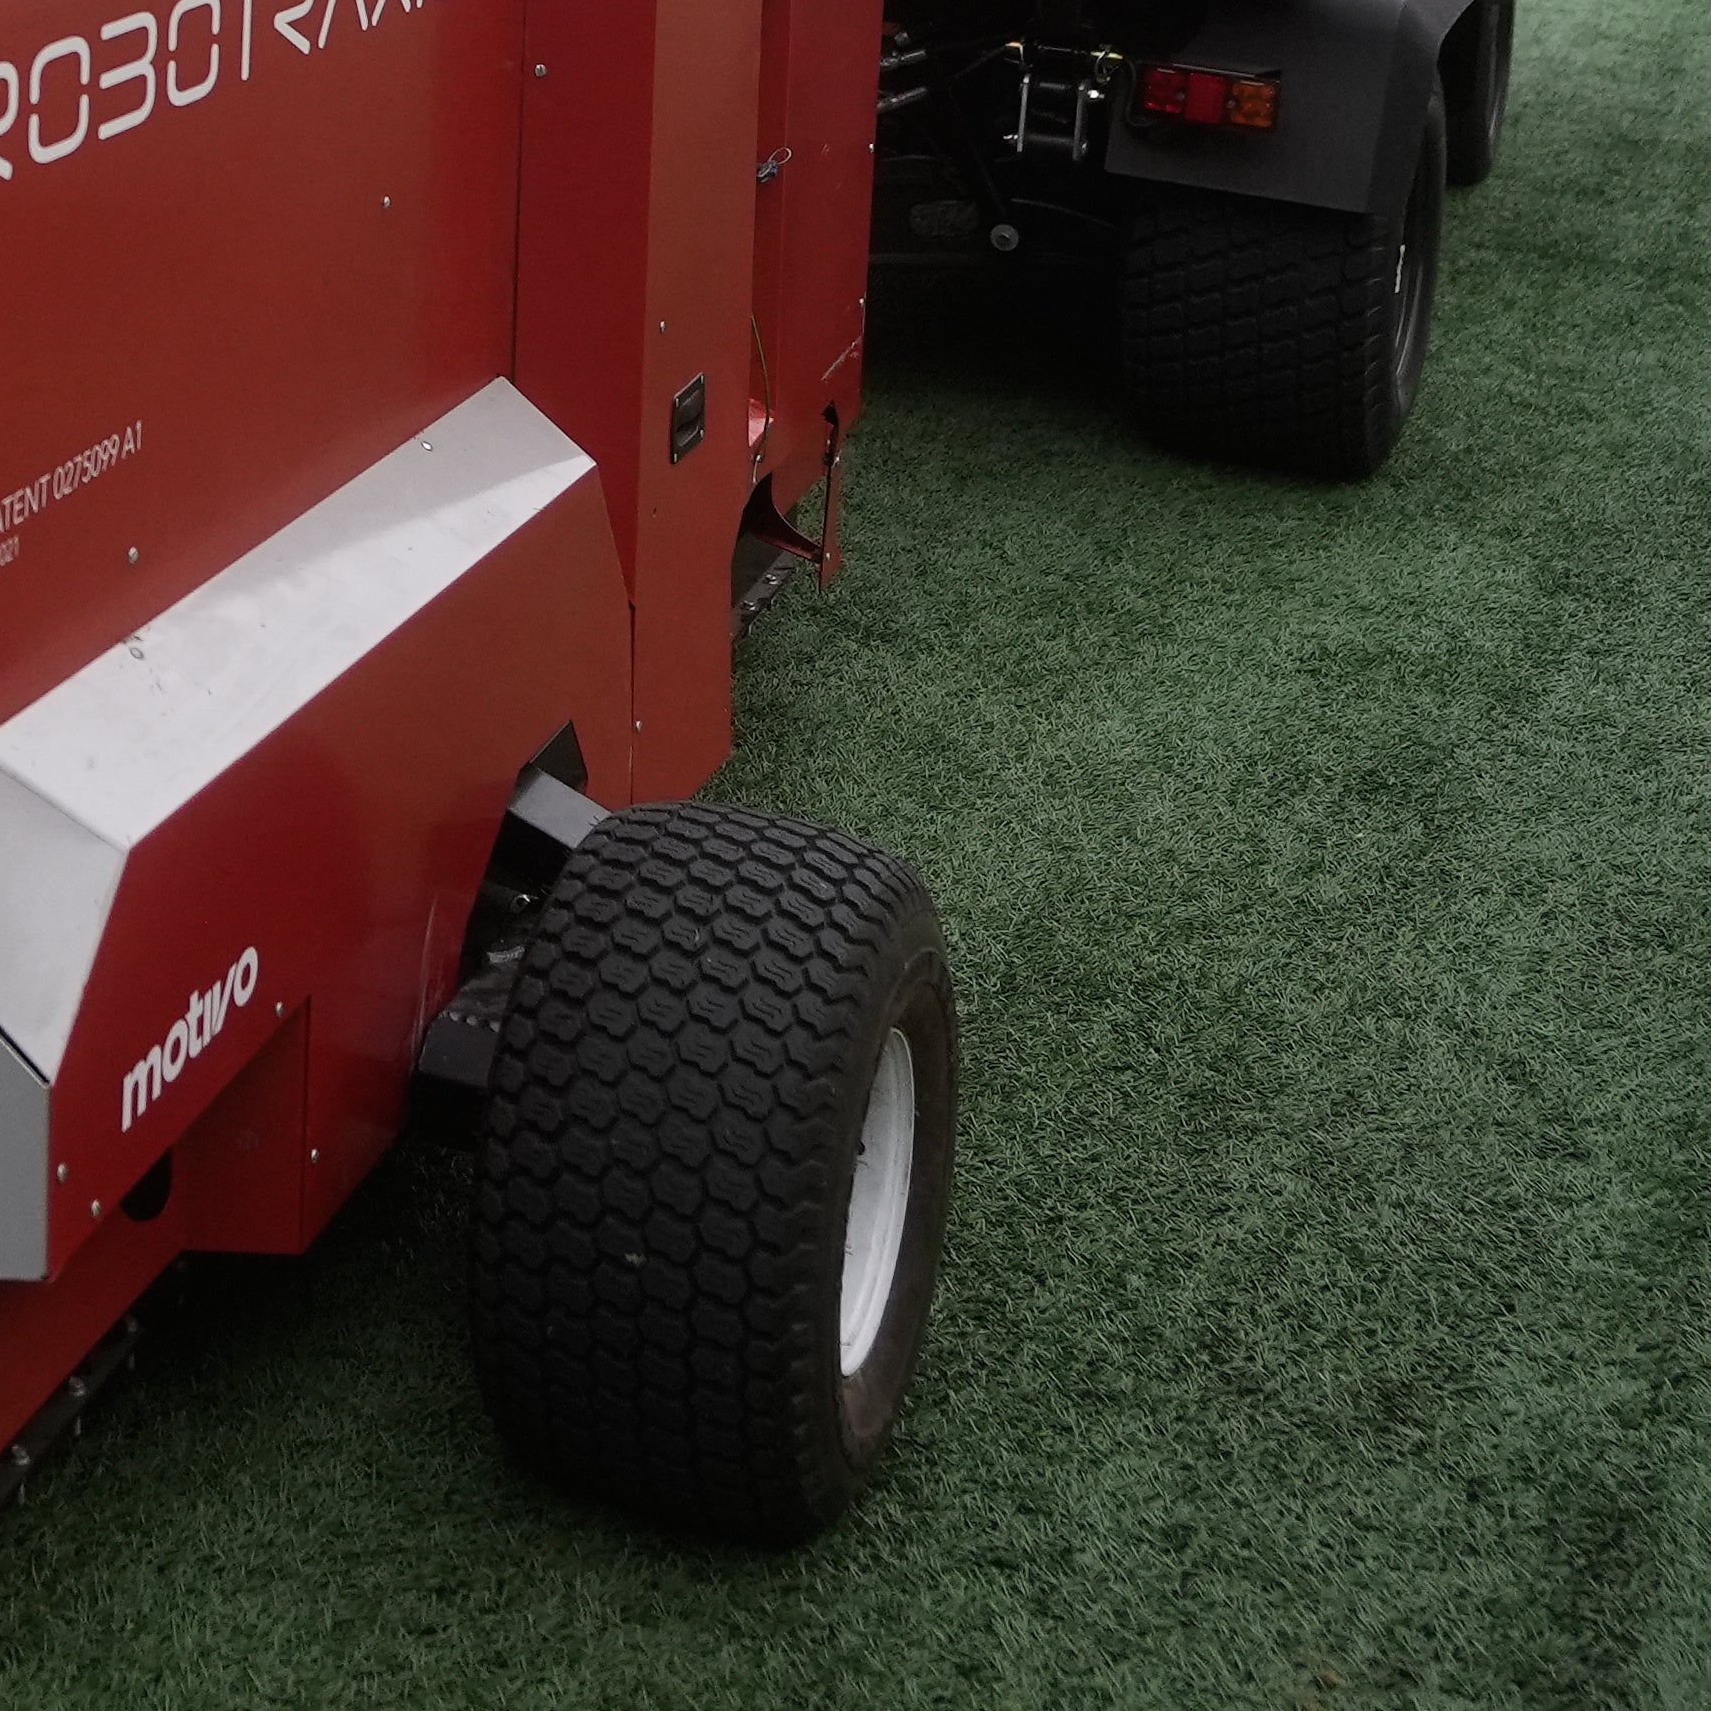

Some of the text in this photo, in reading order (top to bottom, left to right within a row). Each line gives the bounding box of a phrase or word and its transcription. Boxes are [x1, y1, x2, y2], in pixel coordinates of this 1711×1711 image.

[52, 434, 121, 501] 0275099
[121, 418, 143, 460] A1
[120, 945, 260, 1134] motivo
